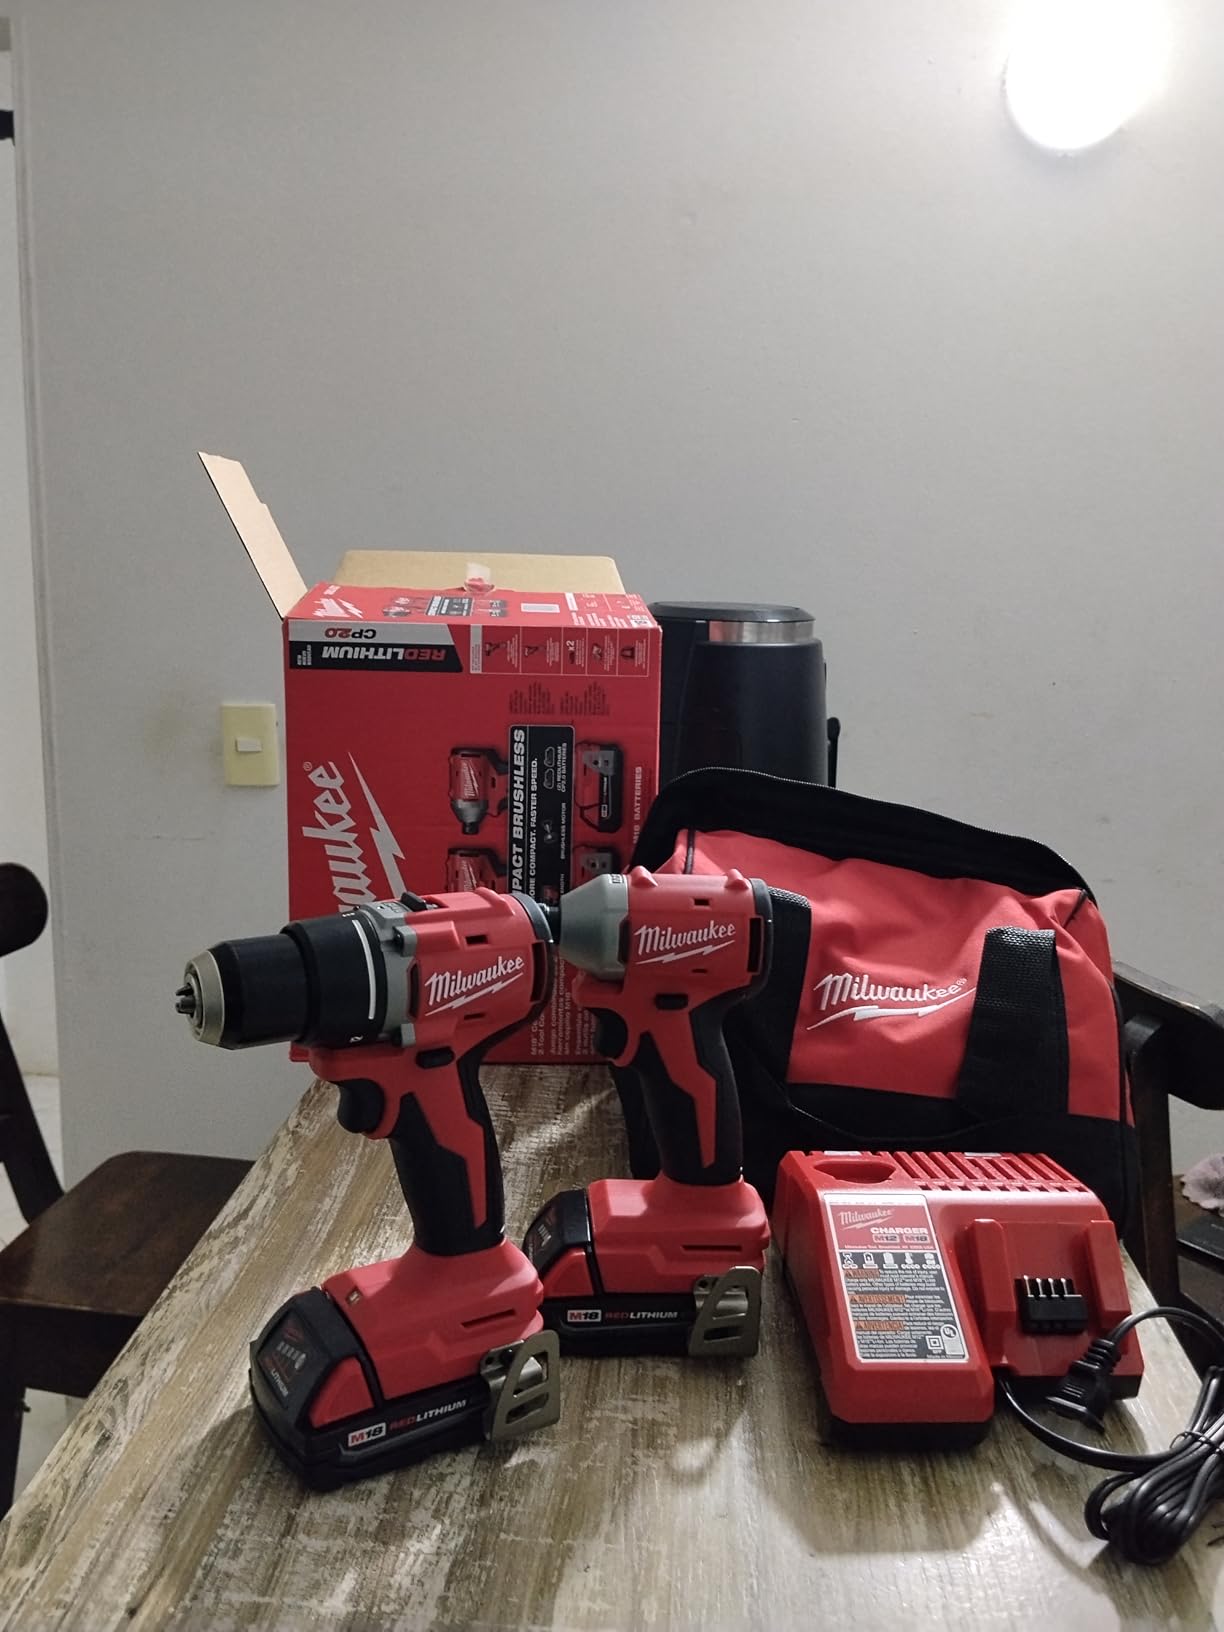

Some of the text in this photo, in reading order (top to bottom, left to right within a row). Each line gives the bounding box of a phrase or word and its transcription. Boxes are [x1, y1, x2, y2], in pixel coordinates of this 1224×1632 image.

[325, 628, 377, 640] CP2.0
[566, 640, 575, 651] x2
[322, 646, 447, 660] REDLITHIUM
[513, 729, 525, 838] BRUSHLESS
[634, 766, 642, 820] BATTERIES
[634, 920, 736, 956] Milwaukee
[424, 956, 524, 1006] Milwaukee
[838, 1209, 892, 1225] Milwaukee
[569, 1311, 678, 1321] M18 REDLITHIUM
[350, 1399, 467, 1445] M18 REDLITHIUM
